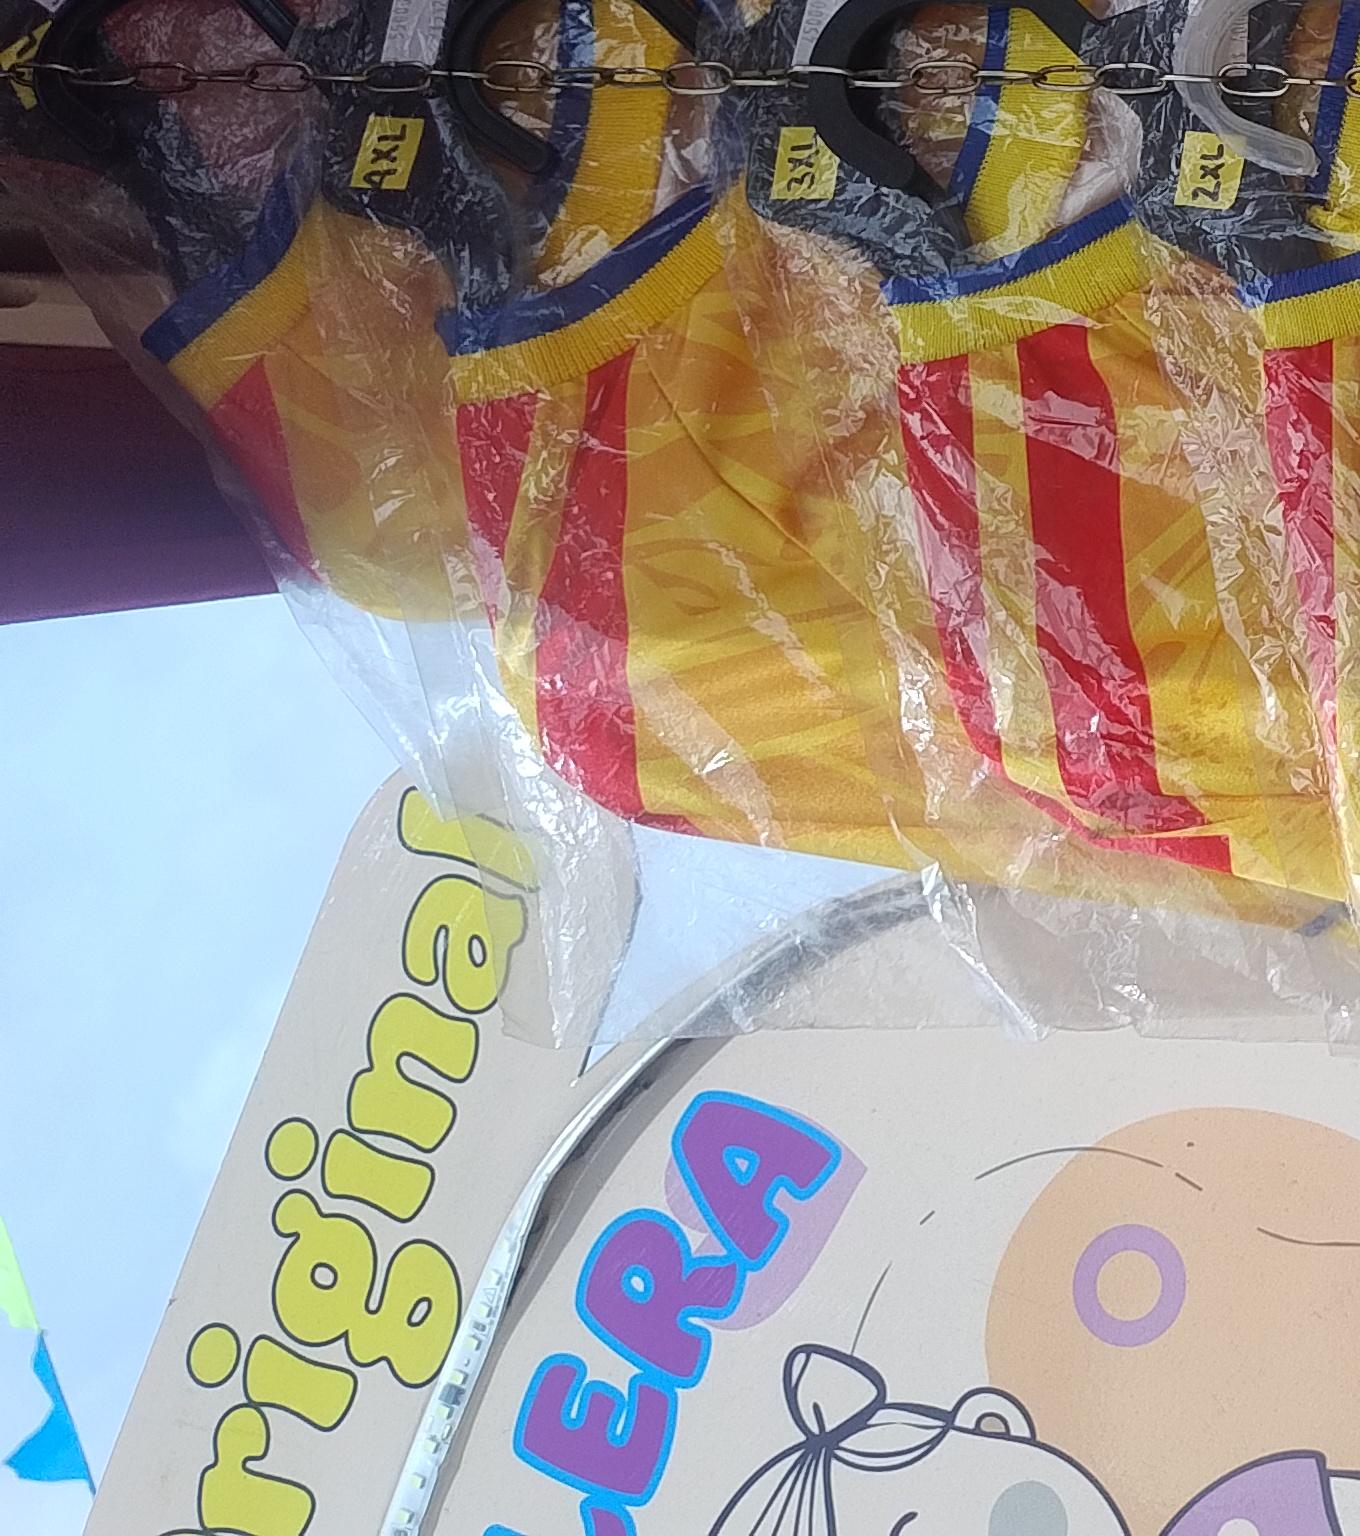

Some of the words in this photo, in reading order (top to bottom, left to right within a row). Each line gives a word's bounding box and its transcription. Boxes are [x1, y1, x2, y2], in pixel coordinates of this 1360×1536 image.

[786, 132, 820, 193] 3XL
[1191, 143, 1225, 202] 2XL
[155, 786, 541, 1536] riginal
